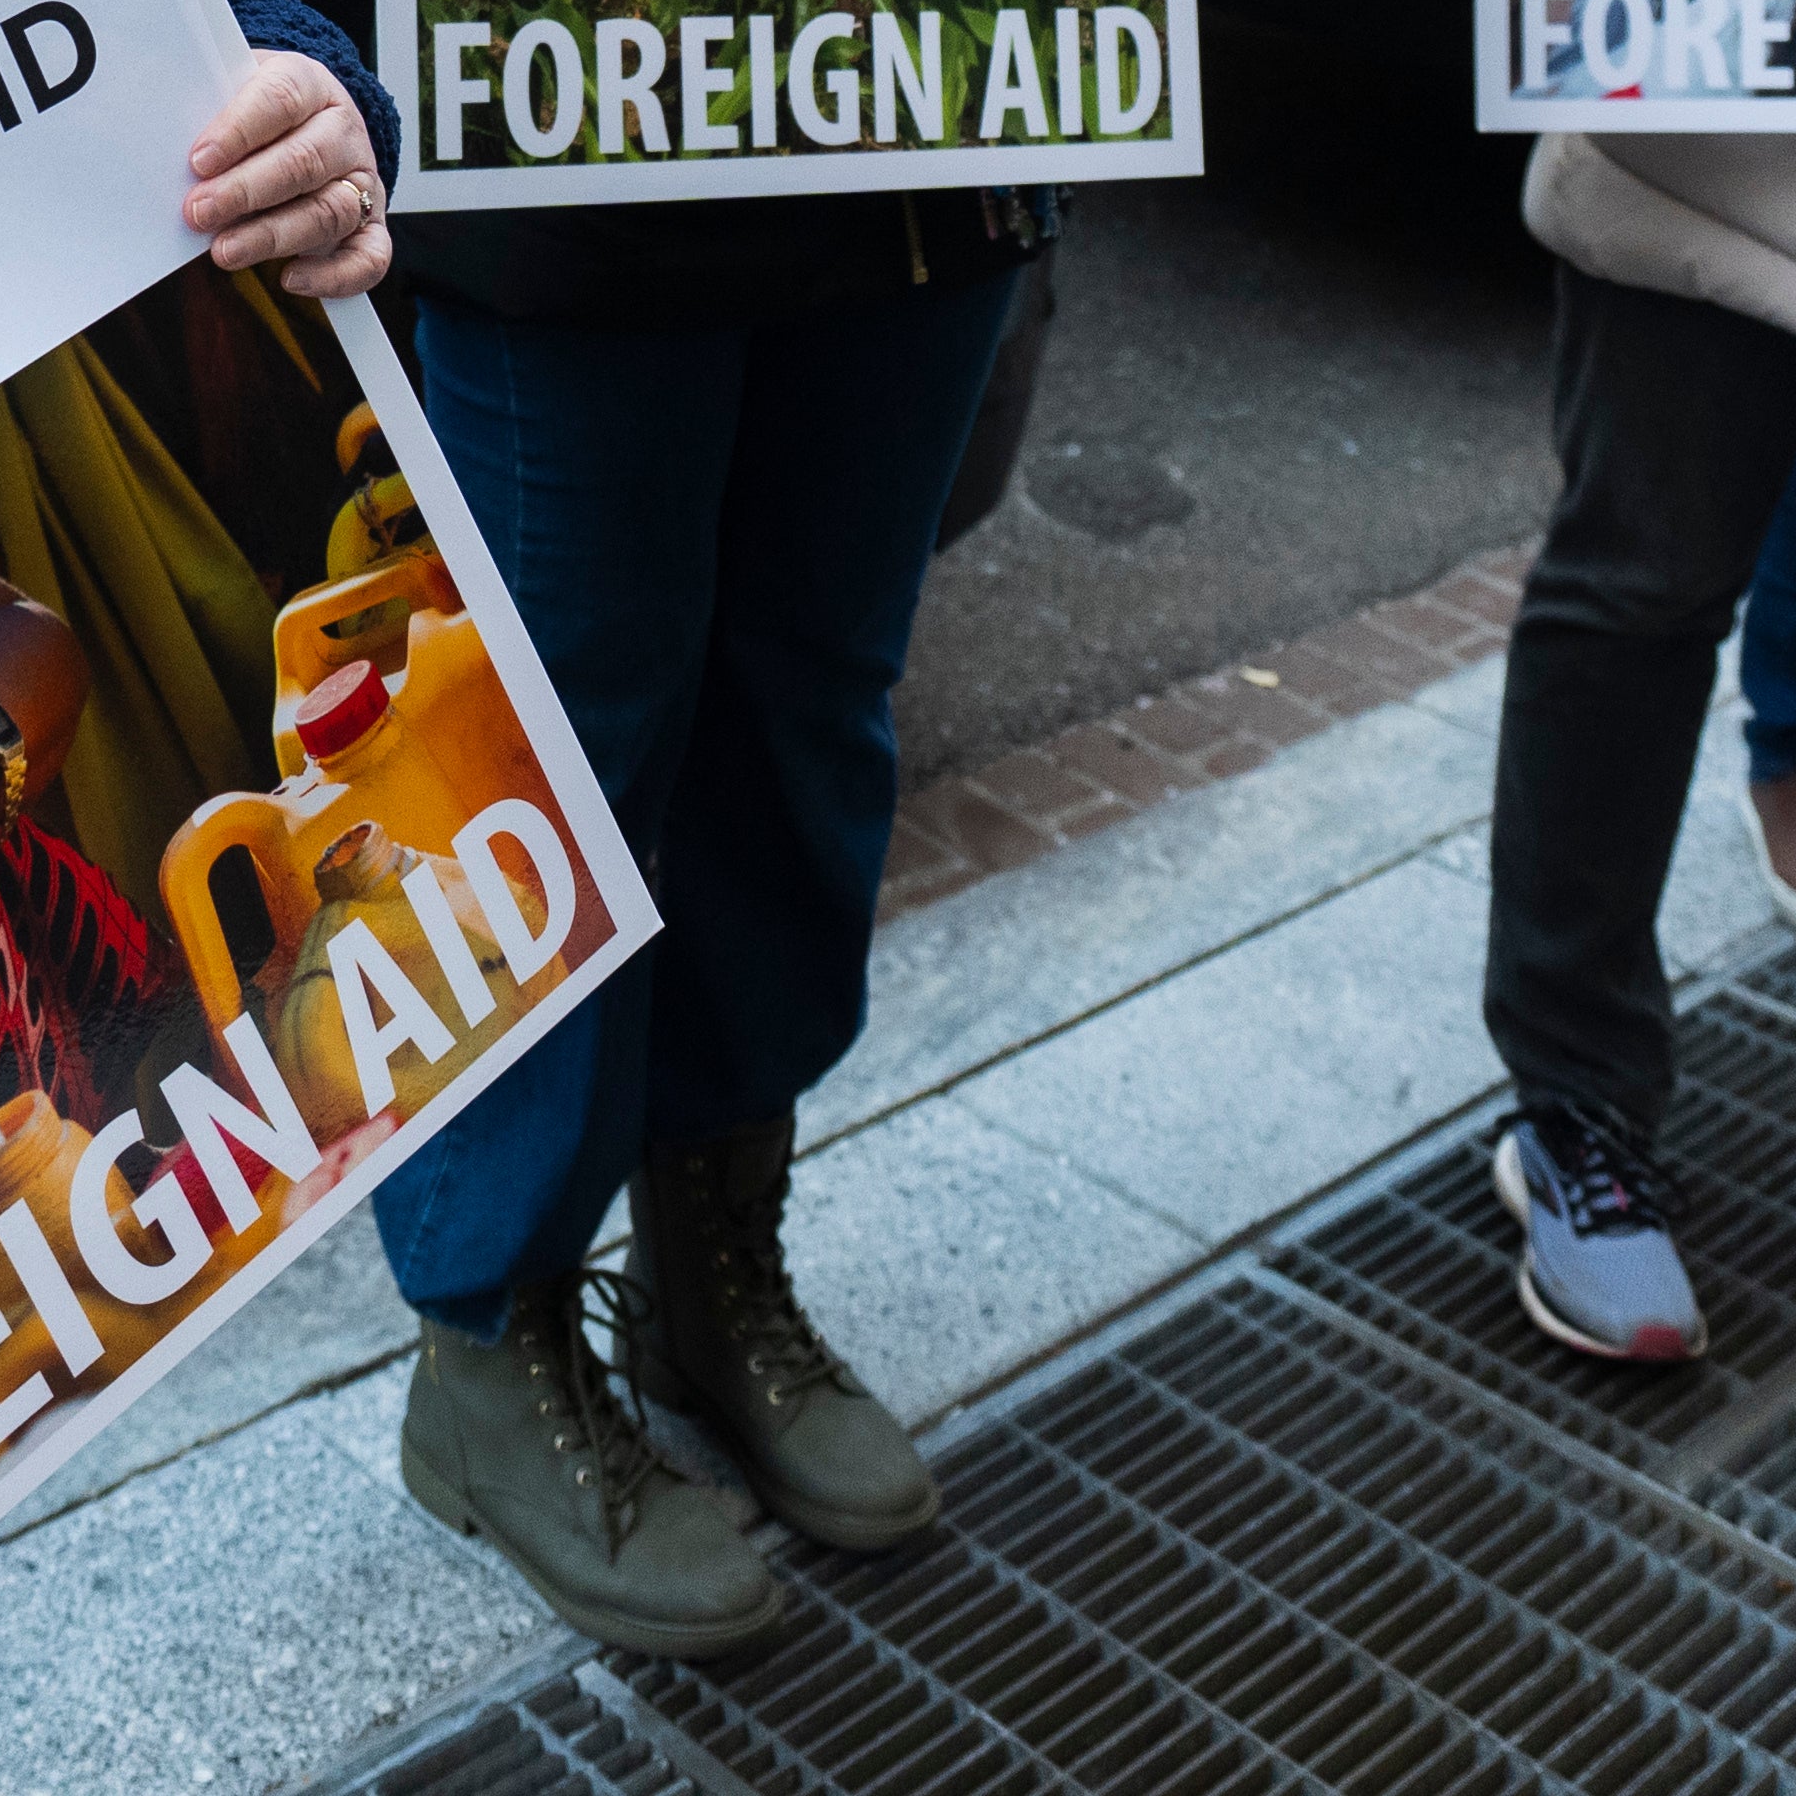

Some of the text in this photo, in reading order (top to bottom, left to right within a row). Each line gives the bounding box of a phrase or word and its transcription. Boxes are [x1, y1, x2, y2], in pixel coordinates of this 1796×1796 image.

[433, 5, 1163, 161] FOREIGN AID
[325, 797, 578, 1118] AID
